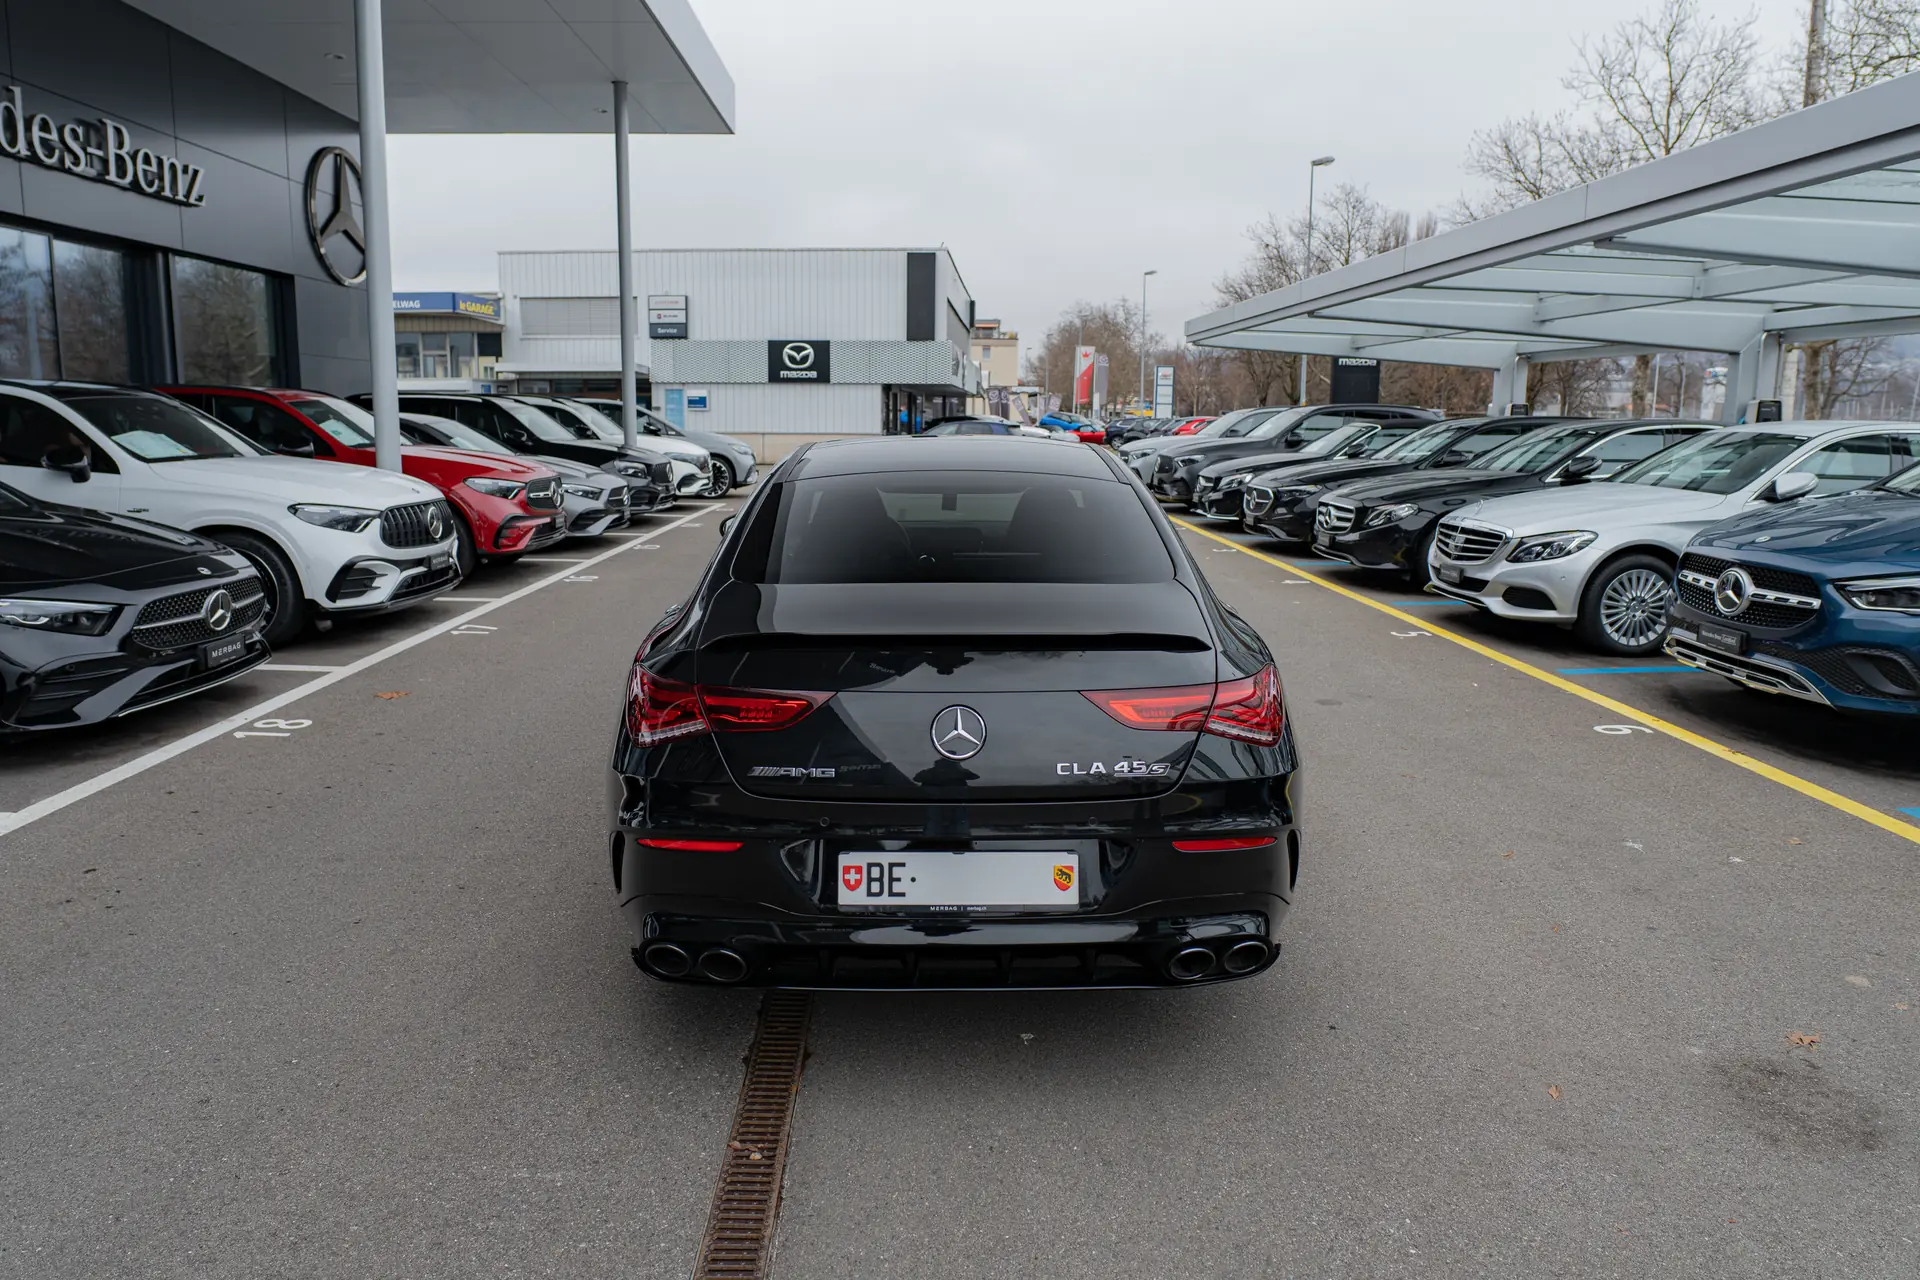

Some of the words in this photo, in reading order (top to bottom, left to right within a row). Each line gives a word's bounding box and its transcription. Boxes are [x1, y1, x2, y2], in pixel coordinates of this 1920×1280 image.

[466, 301, 495, 315] GARAGE
[1339, 358, 1377, 366] mazda
[780, 370, 817, 378] mazda
[450, 624, 498, 634] 17
[211, 641, 241, 657] MERBAG
[233, 718, 313, 738] 18
[1056, 762, 1106, 775] CLA
